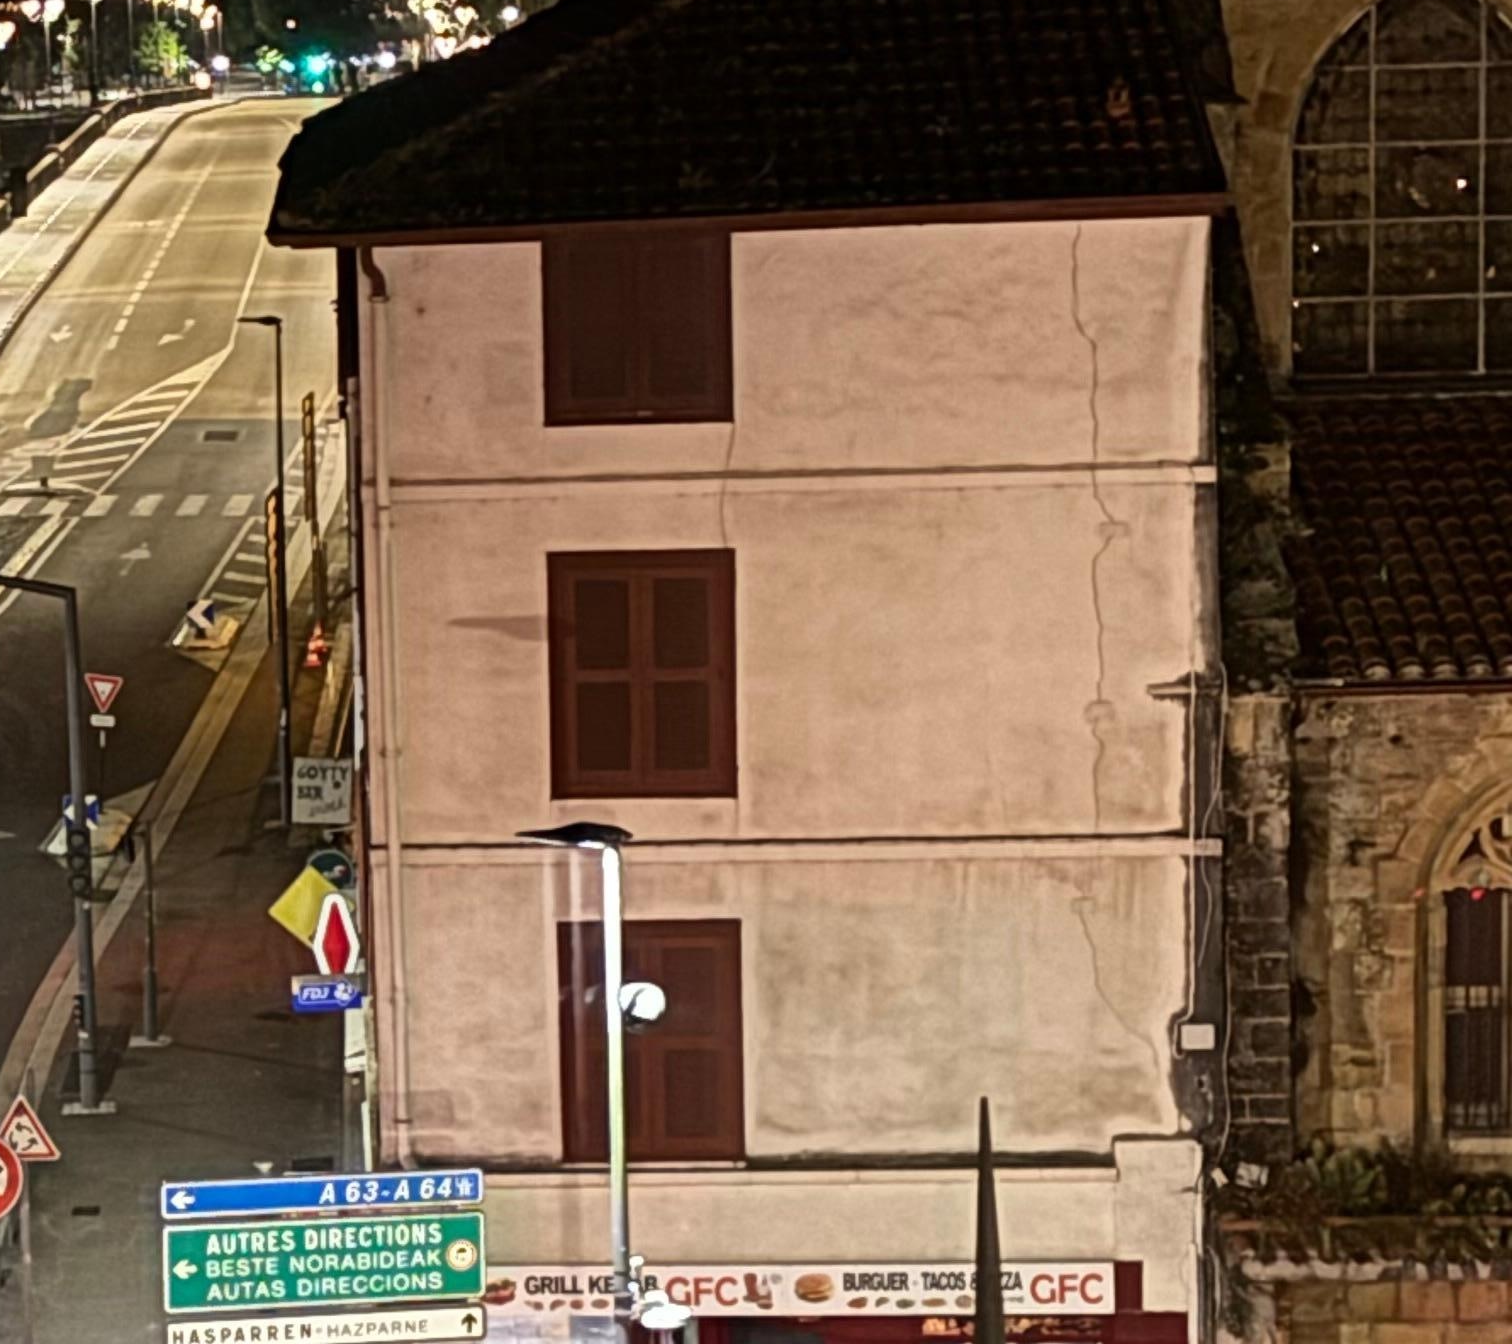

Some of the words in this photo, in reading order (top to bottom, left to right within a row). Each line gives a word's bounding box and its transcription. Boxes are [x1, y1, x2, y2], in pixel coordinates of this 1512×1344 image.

[302, 987, 330, 1001] FDJ
[319, 1182, 336, 1204] A
[419, 1177, 453, 1198] 64
[206, 1230, 295, 1256] AUTRES
[303, 1223, 443, 1251] DIRECTIONS
[206, 1257, 280, 1278] BESTE
[289, 1249, 443, 1274] NORABIDEAK
[206, 1279, 286, 1301] AUTAS
[296, 1273, 443, 1298] DIRECCIONS
[524, 1275, 584, 1295] GRILL
[664, 1276, 738, 1307] GFC
[842, 1272, 910, 1292] BURGUER
[920, 1271, 967, 1291] TACOS
[1030, 1273, 1104, 1305] GFC
